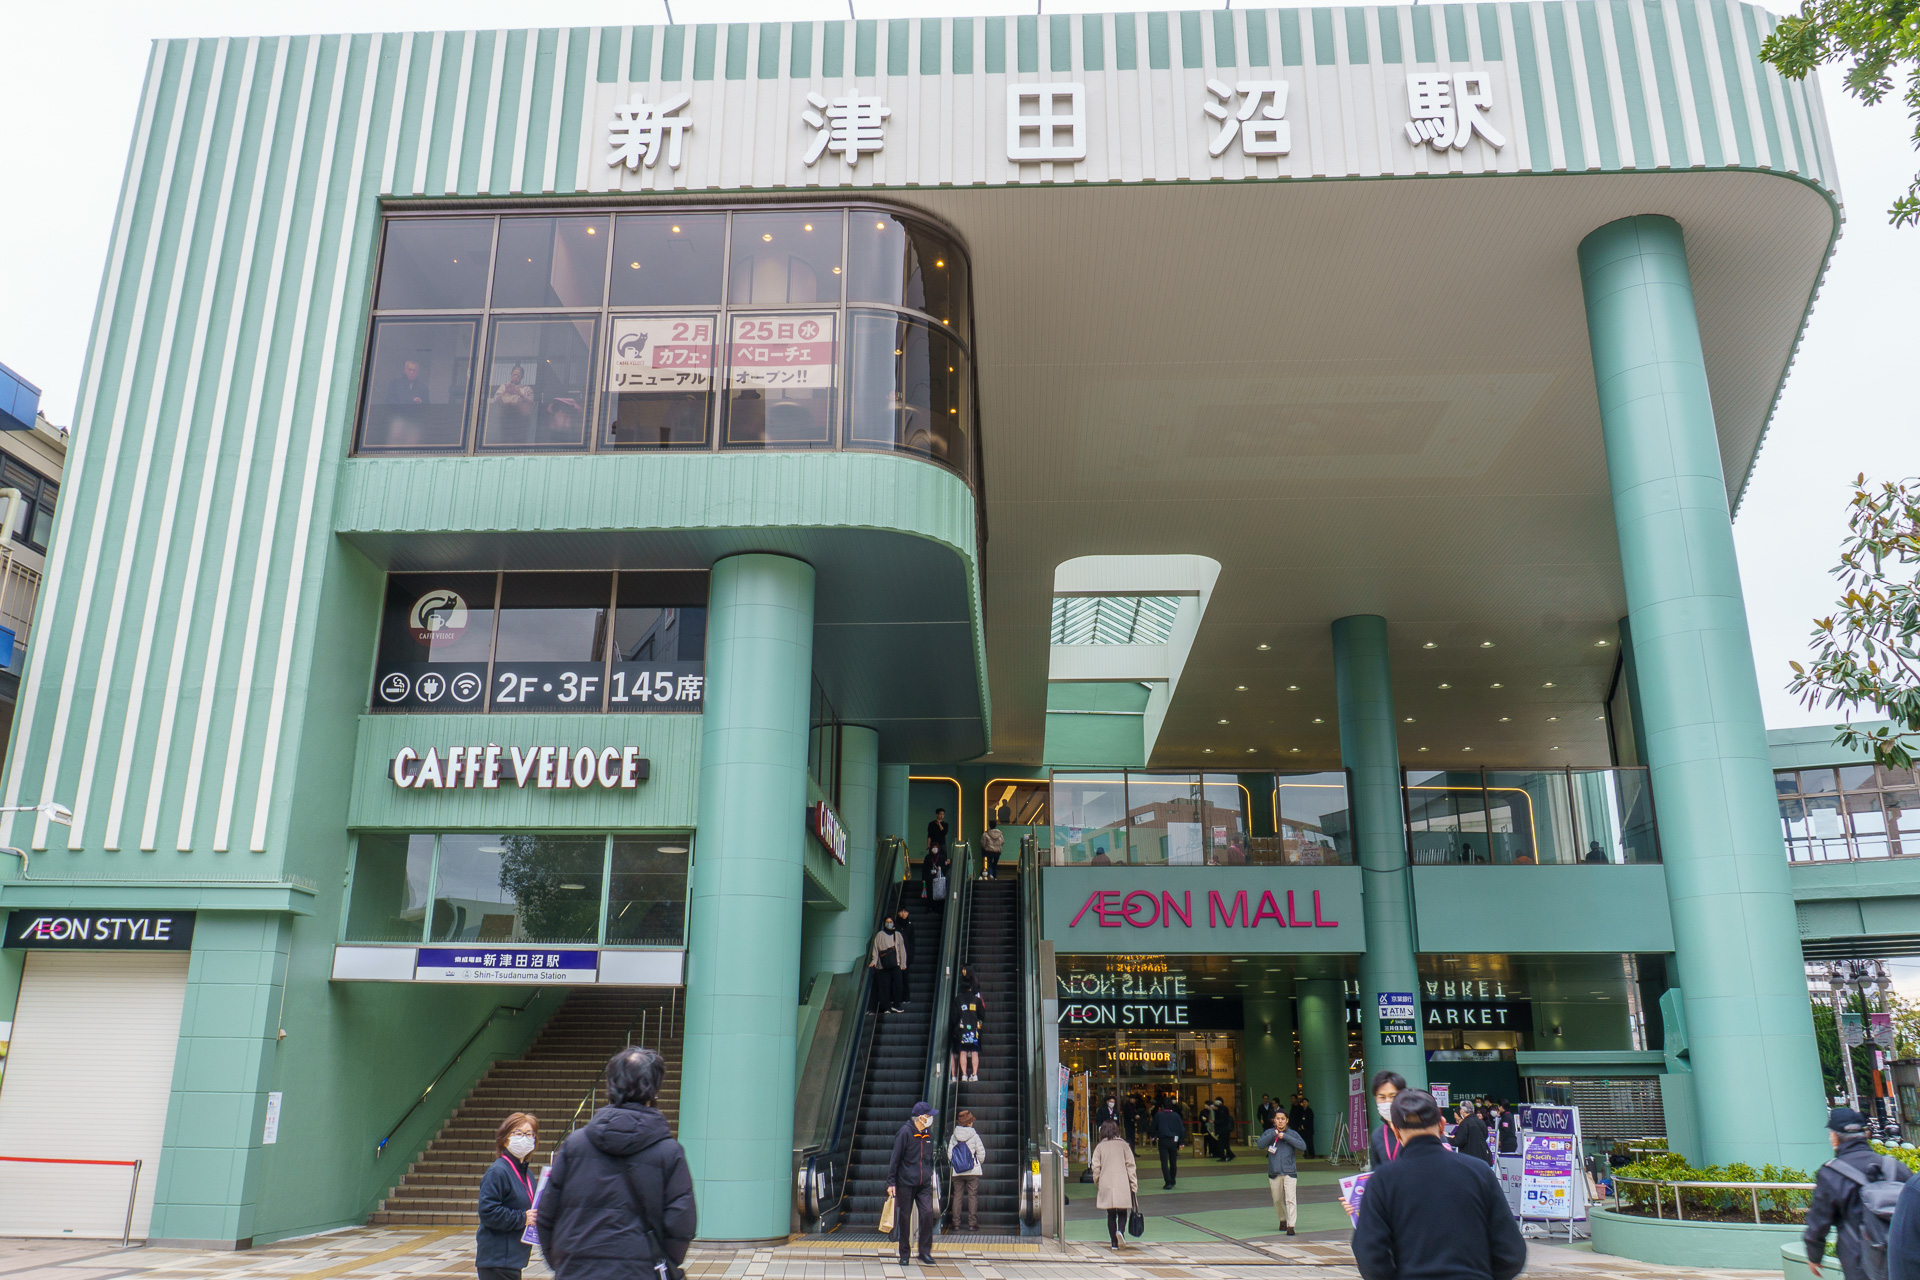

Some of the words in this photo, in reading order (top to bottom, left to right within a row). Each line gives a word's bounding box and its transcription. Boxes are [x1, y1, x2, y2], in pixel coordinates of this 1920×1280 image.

[606, 71, 1506, 173] 新津田沼駅
[672, 322, 709, 342] 2月
[737, 346, 811, 363] ベローチェ
[615, 372, 707, 387] リニューアル
[435, 632, 455, 640] VELOCE
[611, 670, 703, 702] 145席
[509, 745, 640, 789] VELOCE
[1069, 889, 1193, 928] AEON
[1208, 889, 1339, 928] MALL
[19, 917, 91, 941] AEON
[93, 917, 173, 942] STYLE
[483, 953, 560, 968] 新津田沼駅
[474, 970, 539, 980] Shin-Tsudanuma
[540, 971, 567, 981] Station
[1057, 1004, 1116, 1025] AEON
[1122, 1004, 1189, 1025] STYLE
[1389, 1007, 1406, 1015] ATM
[1428, 1008, 1508, 1024] ARKET
[1384, 1034, 1407, 1044] ATM
